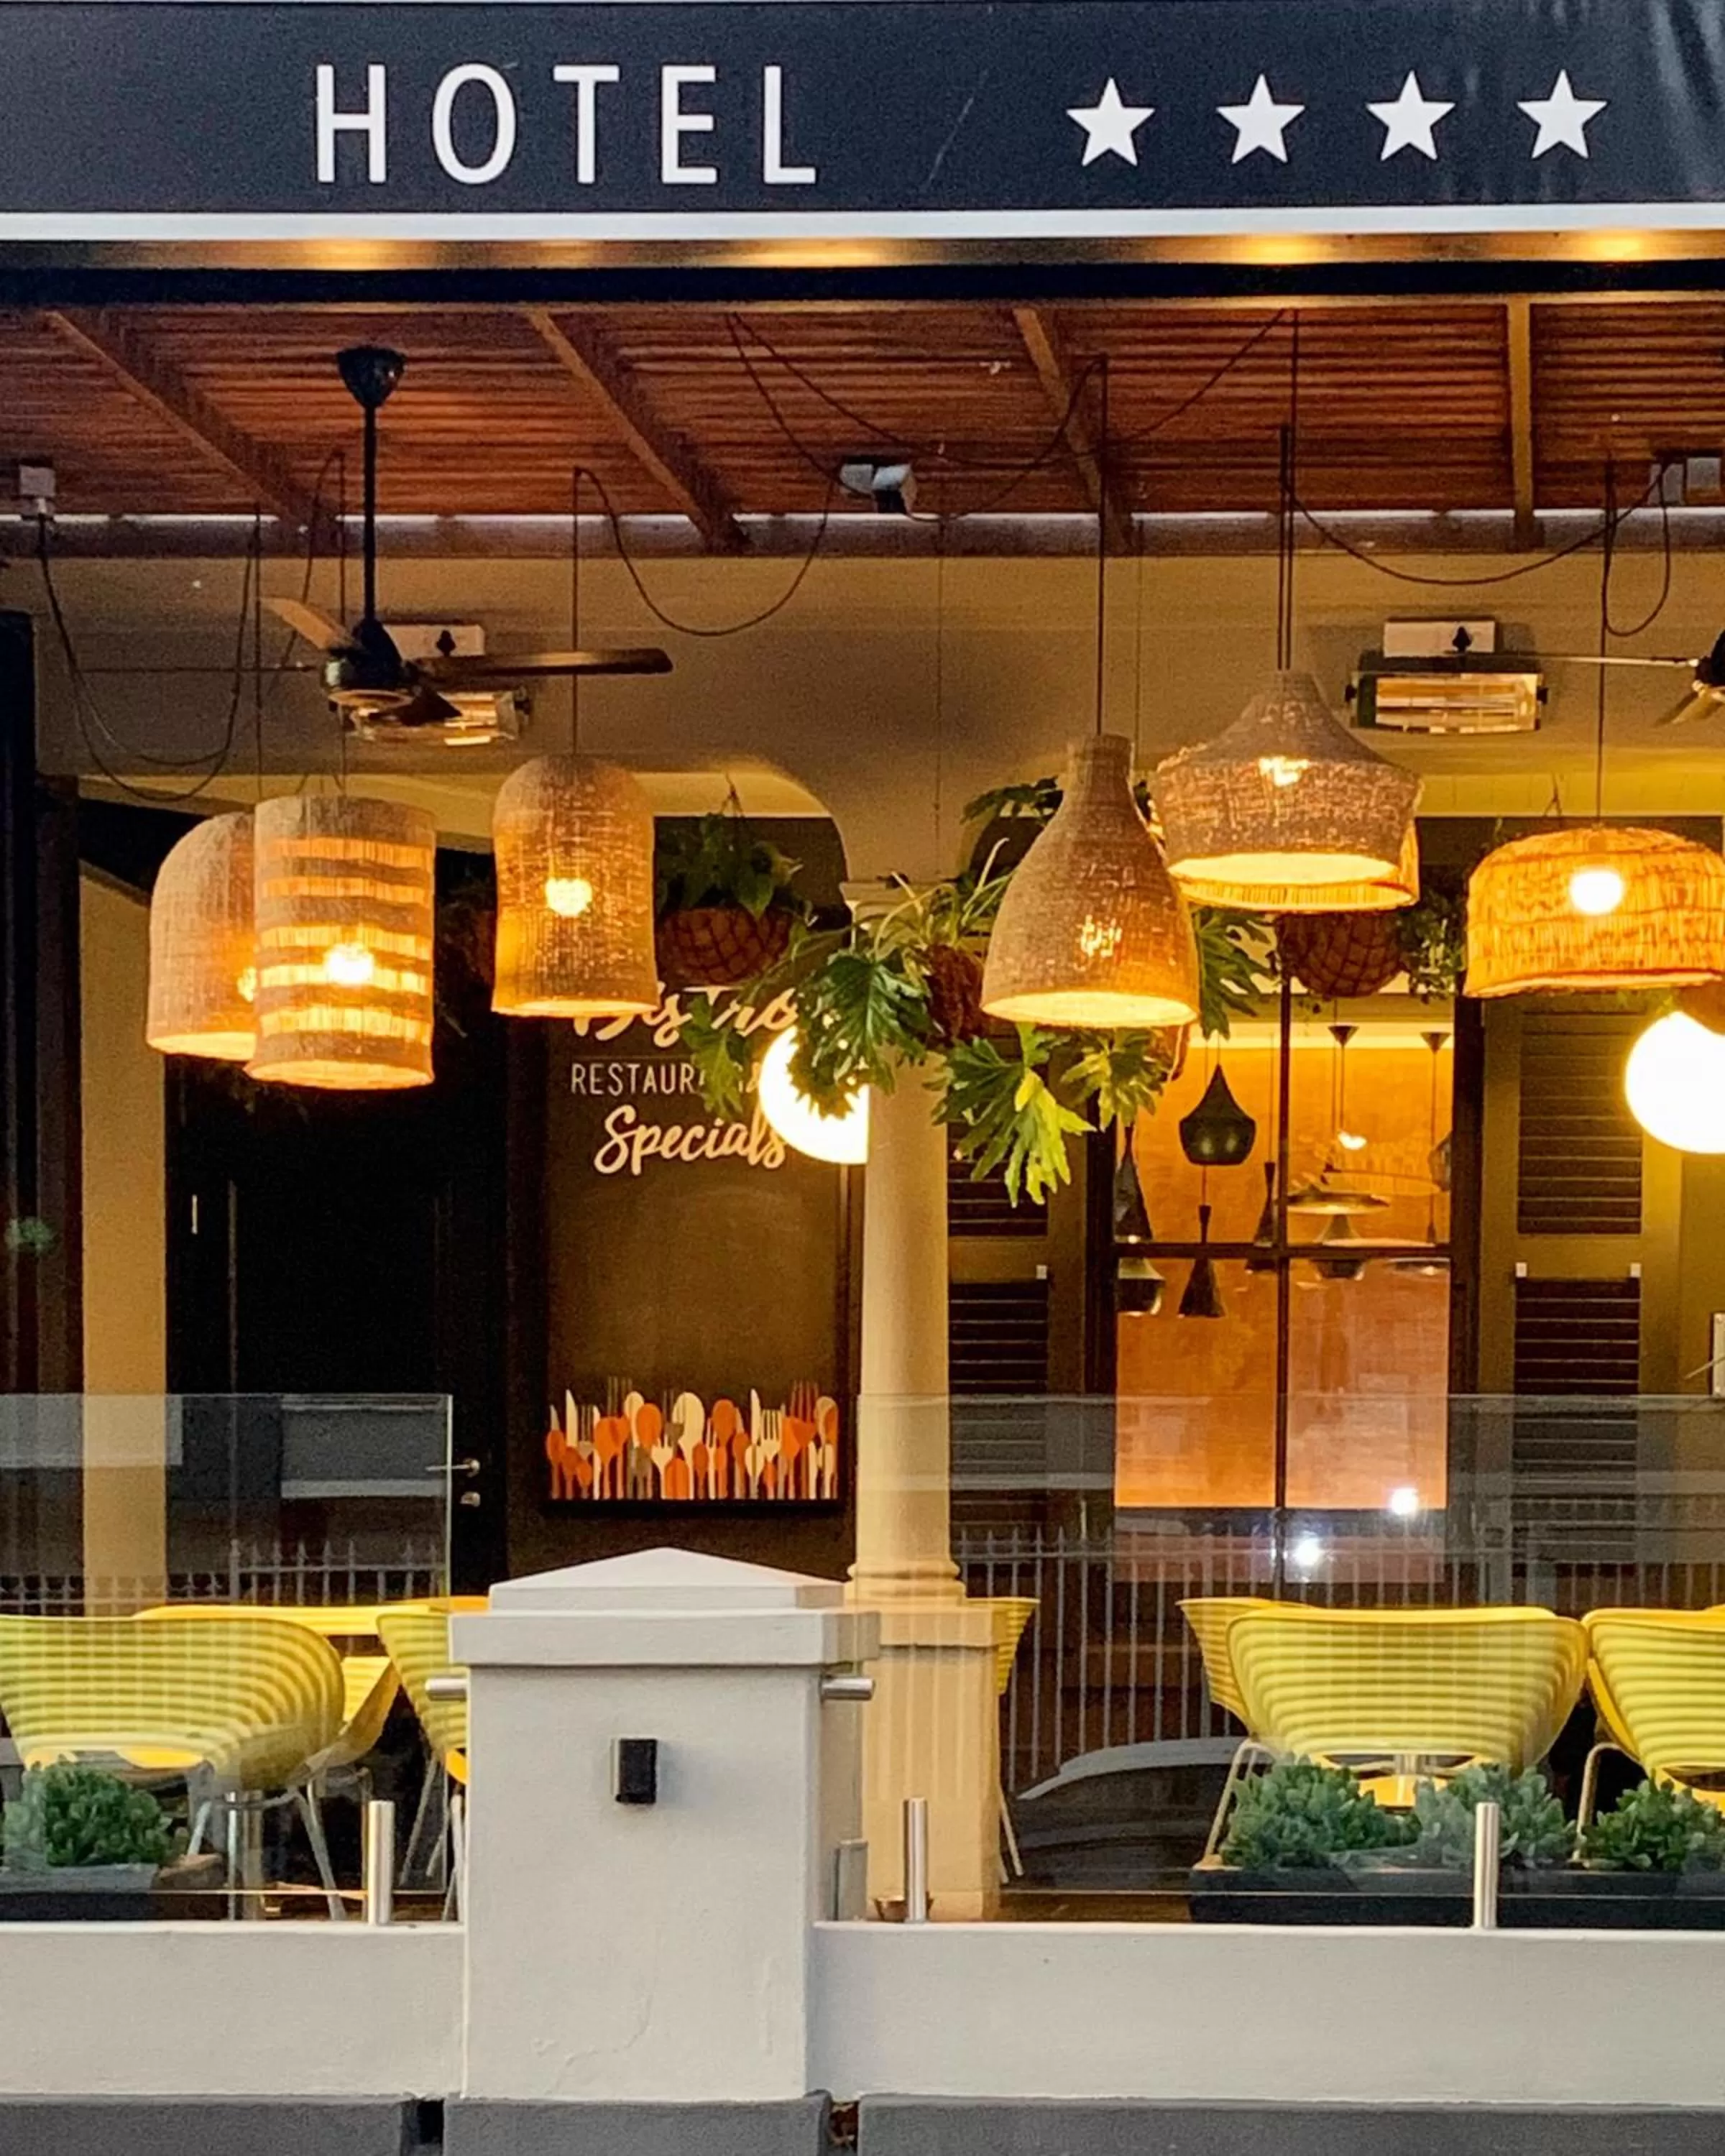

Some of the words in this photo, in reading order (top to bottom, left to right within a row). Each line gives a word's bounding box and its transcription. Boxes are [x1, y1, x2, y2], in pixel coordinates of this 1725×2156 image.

[316, 63, 817, 185] HOTEL
[571, 1062, 745, 1095] RESTAUR
[594, 1101, 786, 1176] Specials
